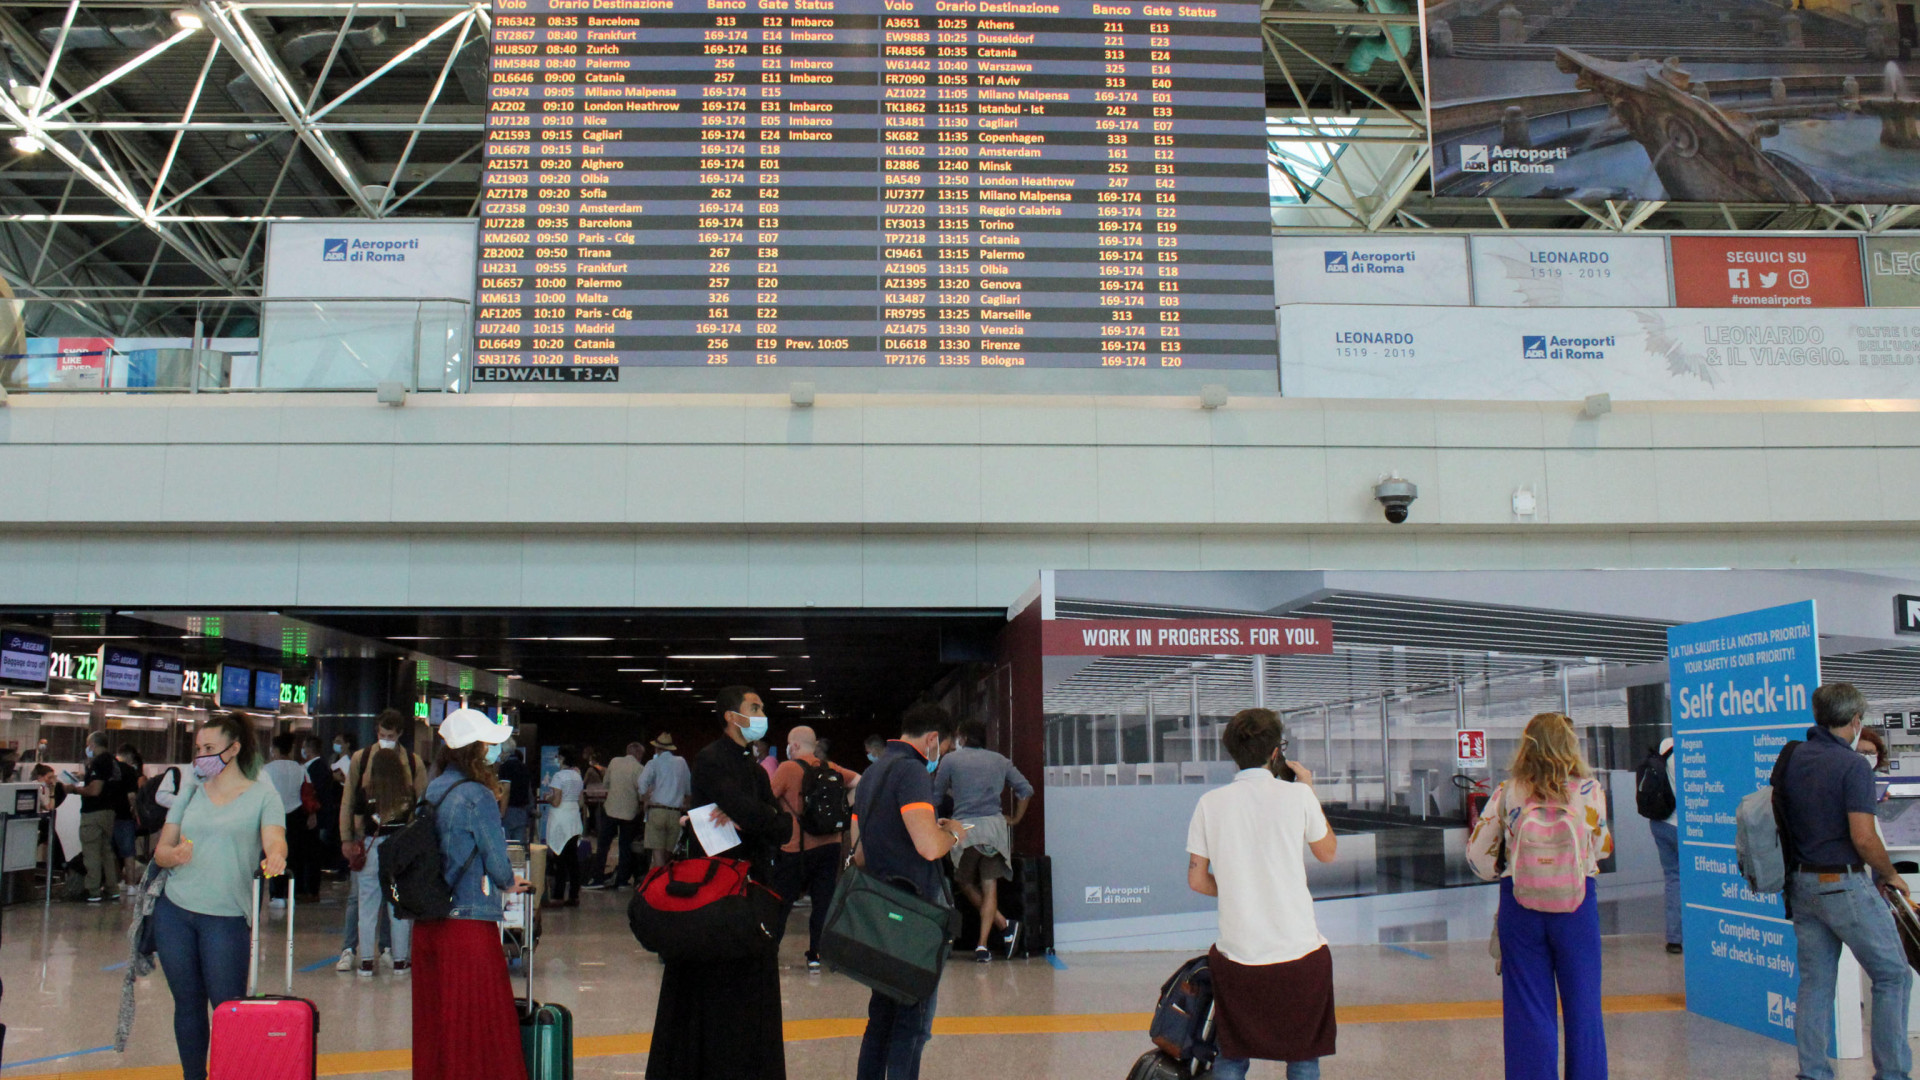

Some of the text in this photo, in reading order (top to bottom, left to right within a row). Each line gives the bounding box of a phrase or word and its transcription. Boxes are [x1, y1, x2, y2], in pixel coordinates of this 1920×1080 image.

[885, 0, 1216, 17] Volo Orario Destinazione Banco Gate Status
[497, 17, 833, 27] FR6342 08:35 Barcelona 313 E12 Imbarco
[886, 61, 1170, 74] W61442 10:40 Warszawa 325 E14
[492, 101, 832, 112] AZ202 09:10 London Heathrow 169-174 E31 Imbarco
[885, 132, 1173, 145] SK682 11:35 Copenhagen 333 E15
[1492, 145, 1566, 160] Aeroporti
[1463, 161, 1487, 171] ADR
[1493, 161, 1555, 174] di Roma
[885, 219, 1176, 232] EY3013 13:15 Torino 169-174 E19
[352, 239, 418, 251] Aeroporti
[351, 252, 404, 261] di Roma
[484, 248, 778, 258] ZB2002 09:50 Tirana 267 E38
[1352, 251, 1415, 264] Aeroporti
[1530, 252, 1608, 263] LEONARDO
[1727, 252, 1806, 263] SEGUICI SU
[1352, 264, 1404, 273] di Roma
[1530, 267, 1563, 278] 1519
[1579, 268, 1610, 278] 2019
[1732, 295, 1811, 307] #romeairports
[1336, 332, 1413, 344] LEONARDO
[1704, 326, 1824, 344] LEONARDO
[1857, 327, 1900, 337] OLTRE
[480, 339, 848, 349] DL6649 10:20 Catania 256 E19 Prev. 10:05
[1550, 336, 1614, 350] Aeroporti
[1337, 348, 1367, 357] 1519
[1385, 349, 1415, 357] 2019
[1551, 349, 1603, 359] di Roma
[1706, 348, 1849, 365] & IL VIAGGIO.
[473, 368, 616, 380] LEDWALL T3-A
[1083, 628, 1319, 647] WORK IN PROGRESS. FOR YOU.
[1671, 648, 1679, 658] LA
[1680, 644, 1694, 656] TUA
[1695, 641, 1719, 654] SALUTE
[1727, 638, 1736, 649] LA
[1738, 631, 1768, 648] NOSTRA
[1770, 621, 1810, 642] PRIORITÀ!
[22, 642, 44, 652] AEGEAN
[4, 656, 25, 667] Baggage
[50, 652, 98, 681] 211 212
[1684, 647, 1795, 674] YOUR SAFETY IS OUR PRIORITY!
[183, 670, 217, 693] 213 214
[280, 683, 306, 703] 215 216
[1680, 675, 1806, 719] Self check-in
[1681, 739, 1703, 751] Aegean
[1753, 734, 1787, 747] Lufthansa
[1682, 753, 1706, 763] Aeroflot
[1755, 752, 1779, 762] Norwe
[1683, 768, 1706, 778] Brussels
[1684, 782, 1704, 795] Cathay
[1705, 781, 1725, 793] Pacific
[1685, 796, 1709, 809] Egyptair
[1686, 812, 1713, 825] Ethiopian
[1687, 826, 1703, 837] Iberia
[1695, 856, 1727, 874] Effettua
[1104, 886, 1150, 895] Aeroporti
[1722, 882, 1738, 898] Self
[1719, 919, 1783, 947] Complete your
[1712, 940, 1794, 978] Self check-in safely
